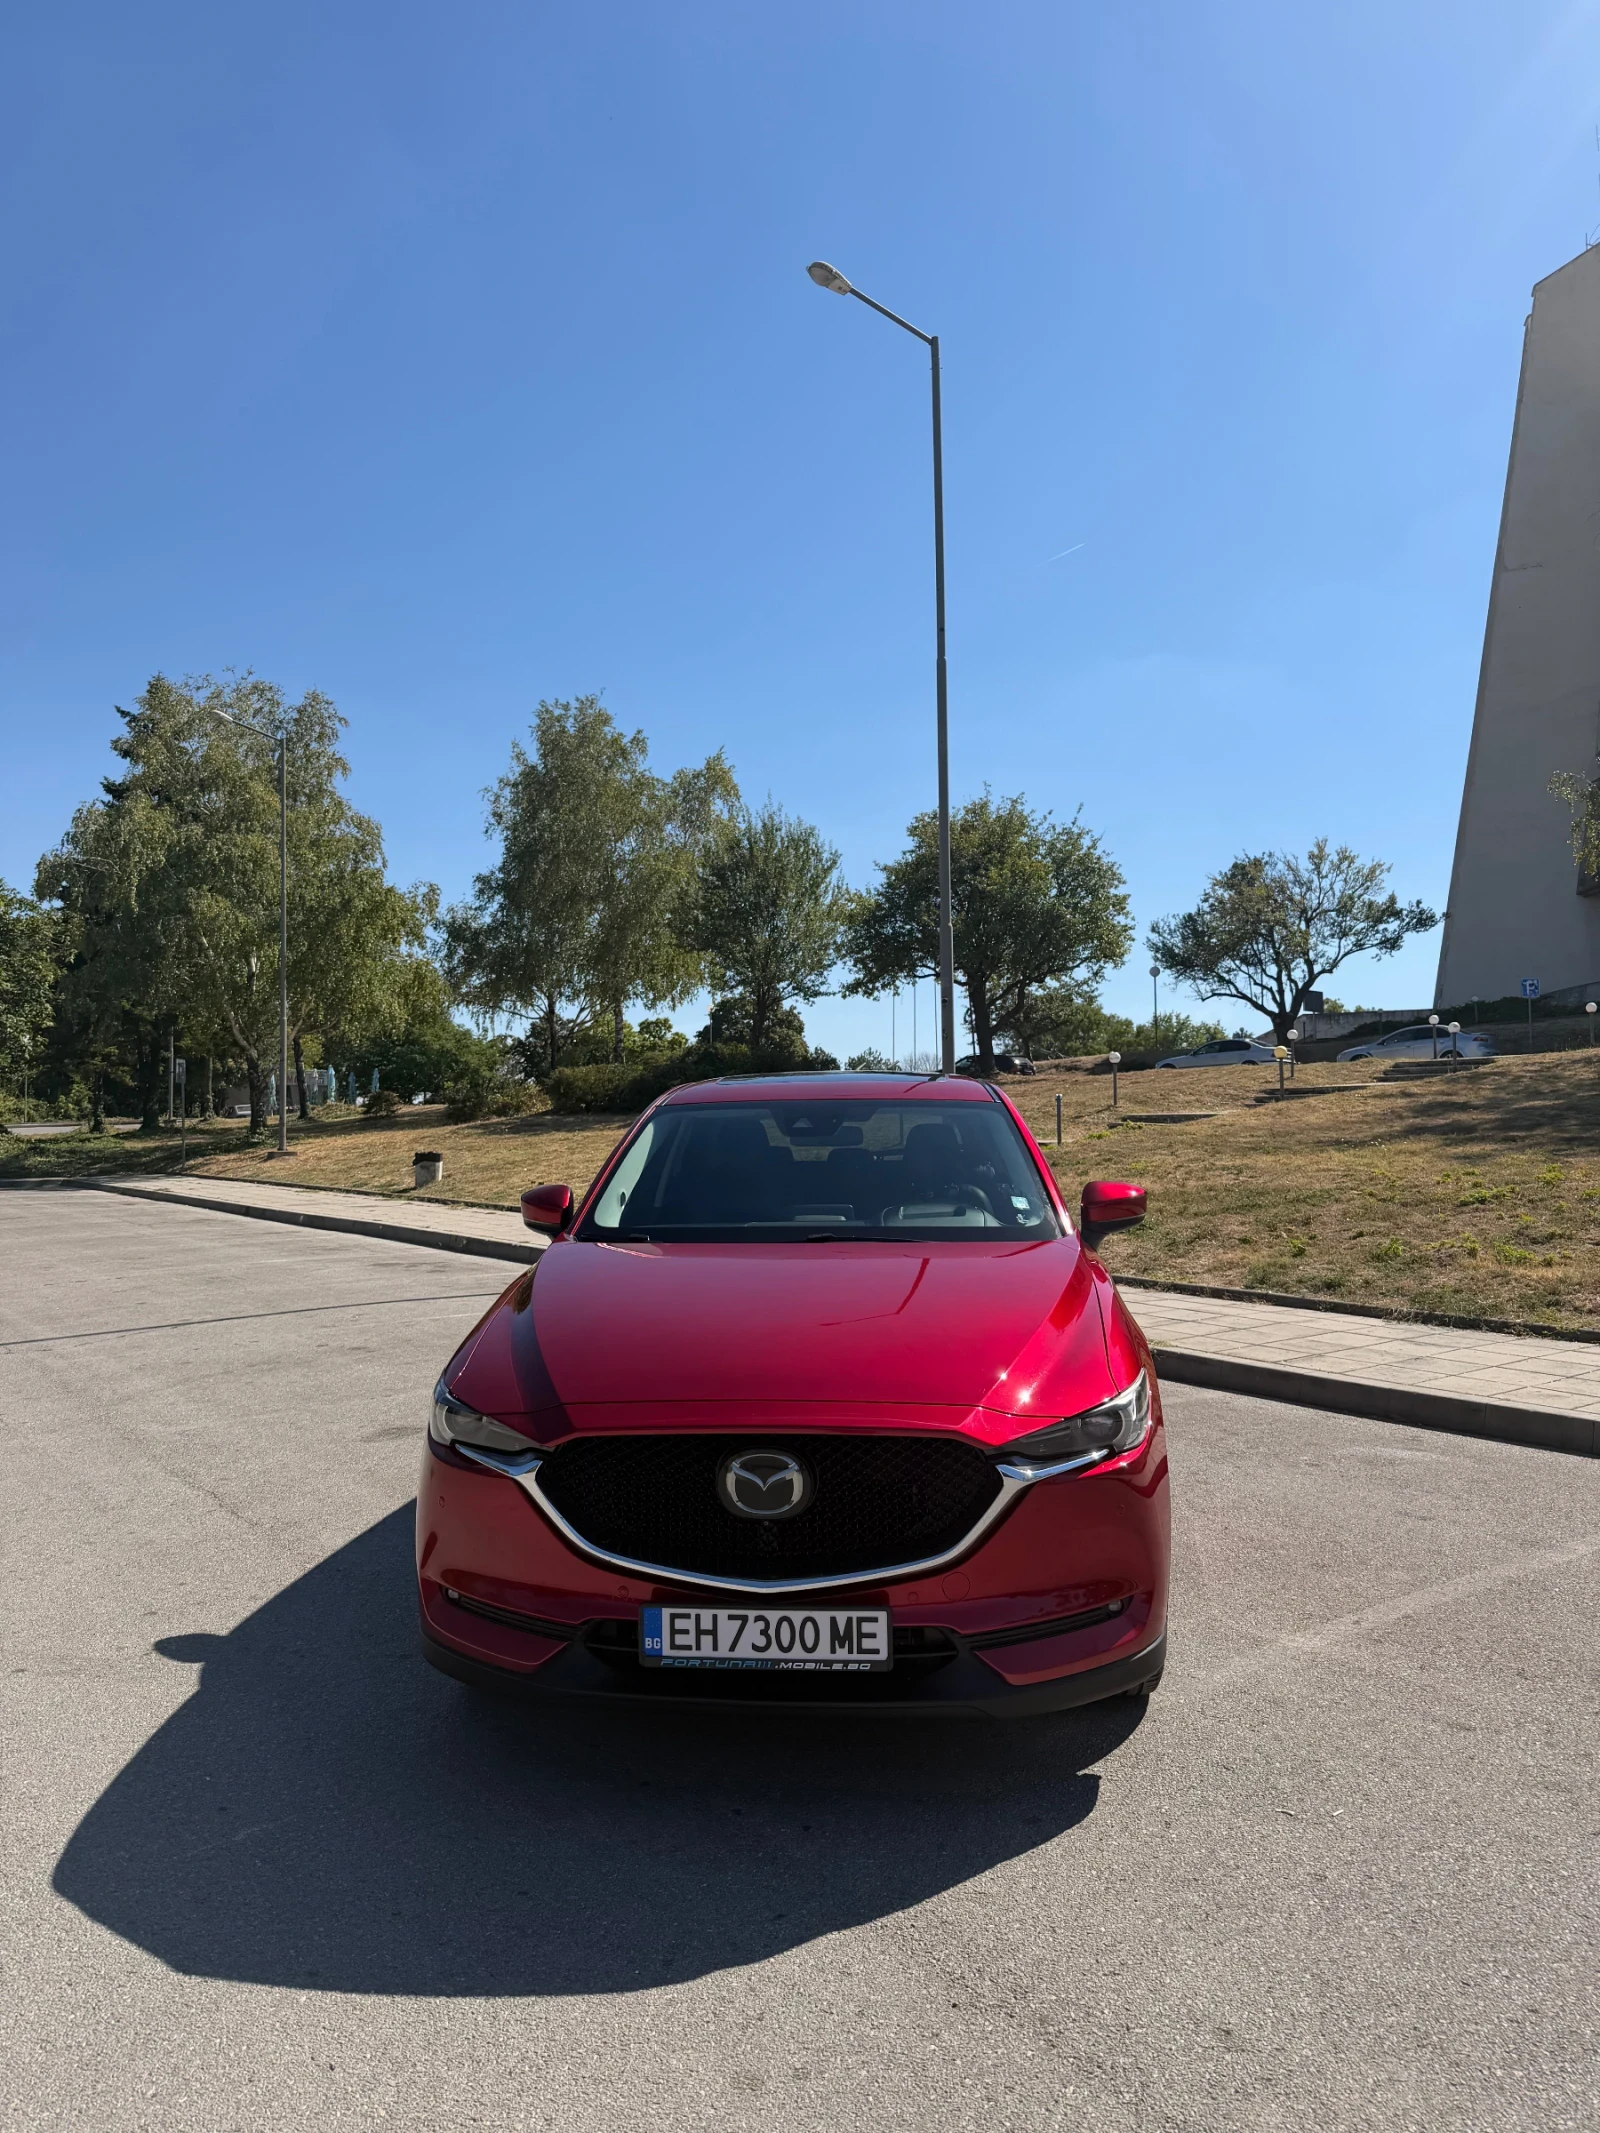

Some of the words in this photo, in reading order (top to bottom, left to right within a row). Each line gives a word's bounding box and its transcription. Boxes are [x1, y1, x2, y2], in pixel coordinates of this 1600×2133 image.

[645, 1637, 661, 1649] BG
[669, 1612, 719, 1652] EH
[727, 1614, 820, 1654] 7300
[829, 1616, 881, 1655] ME
